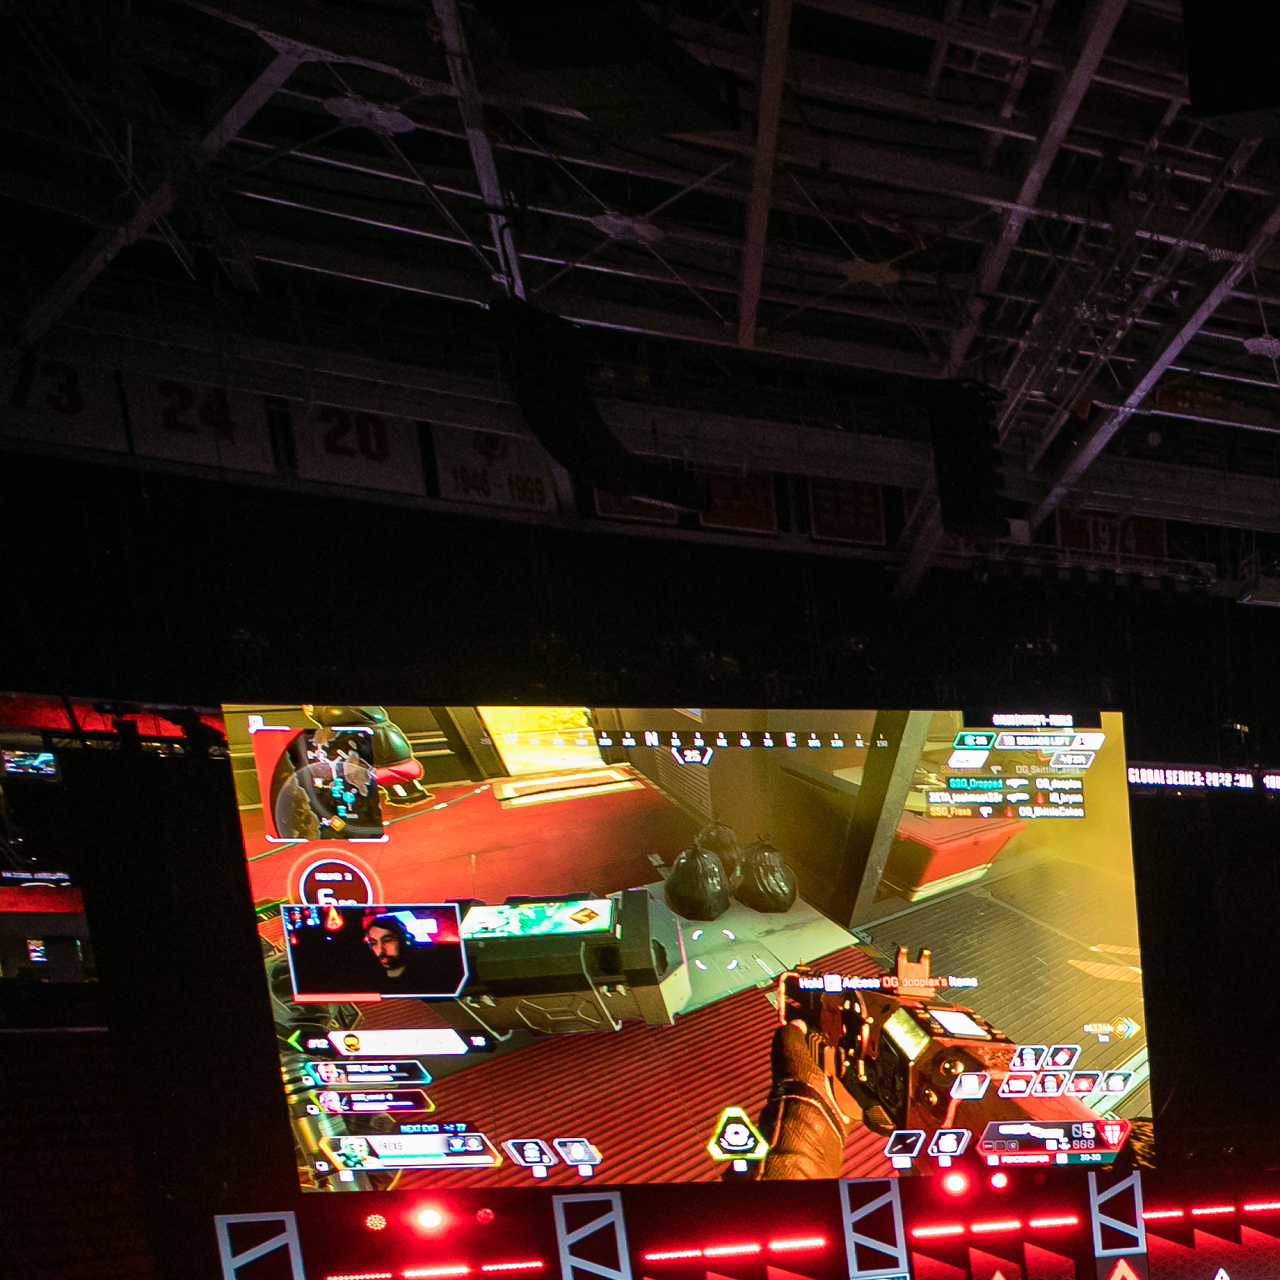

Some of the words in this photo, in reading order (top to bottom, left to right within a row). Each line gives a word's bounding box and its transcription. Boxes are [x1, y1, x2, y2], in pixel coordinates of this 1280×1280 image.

[320, 405, 389, 462] 20
[645, 731, 658, 746] N
[786, 732, 797, 747] E
[683, 750, 702, 763] 25
[799, 977, 823, 989] Hold
